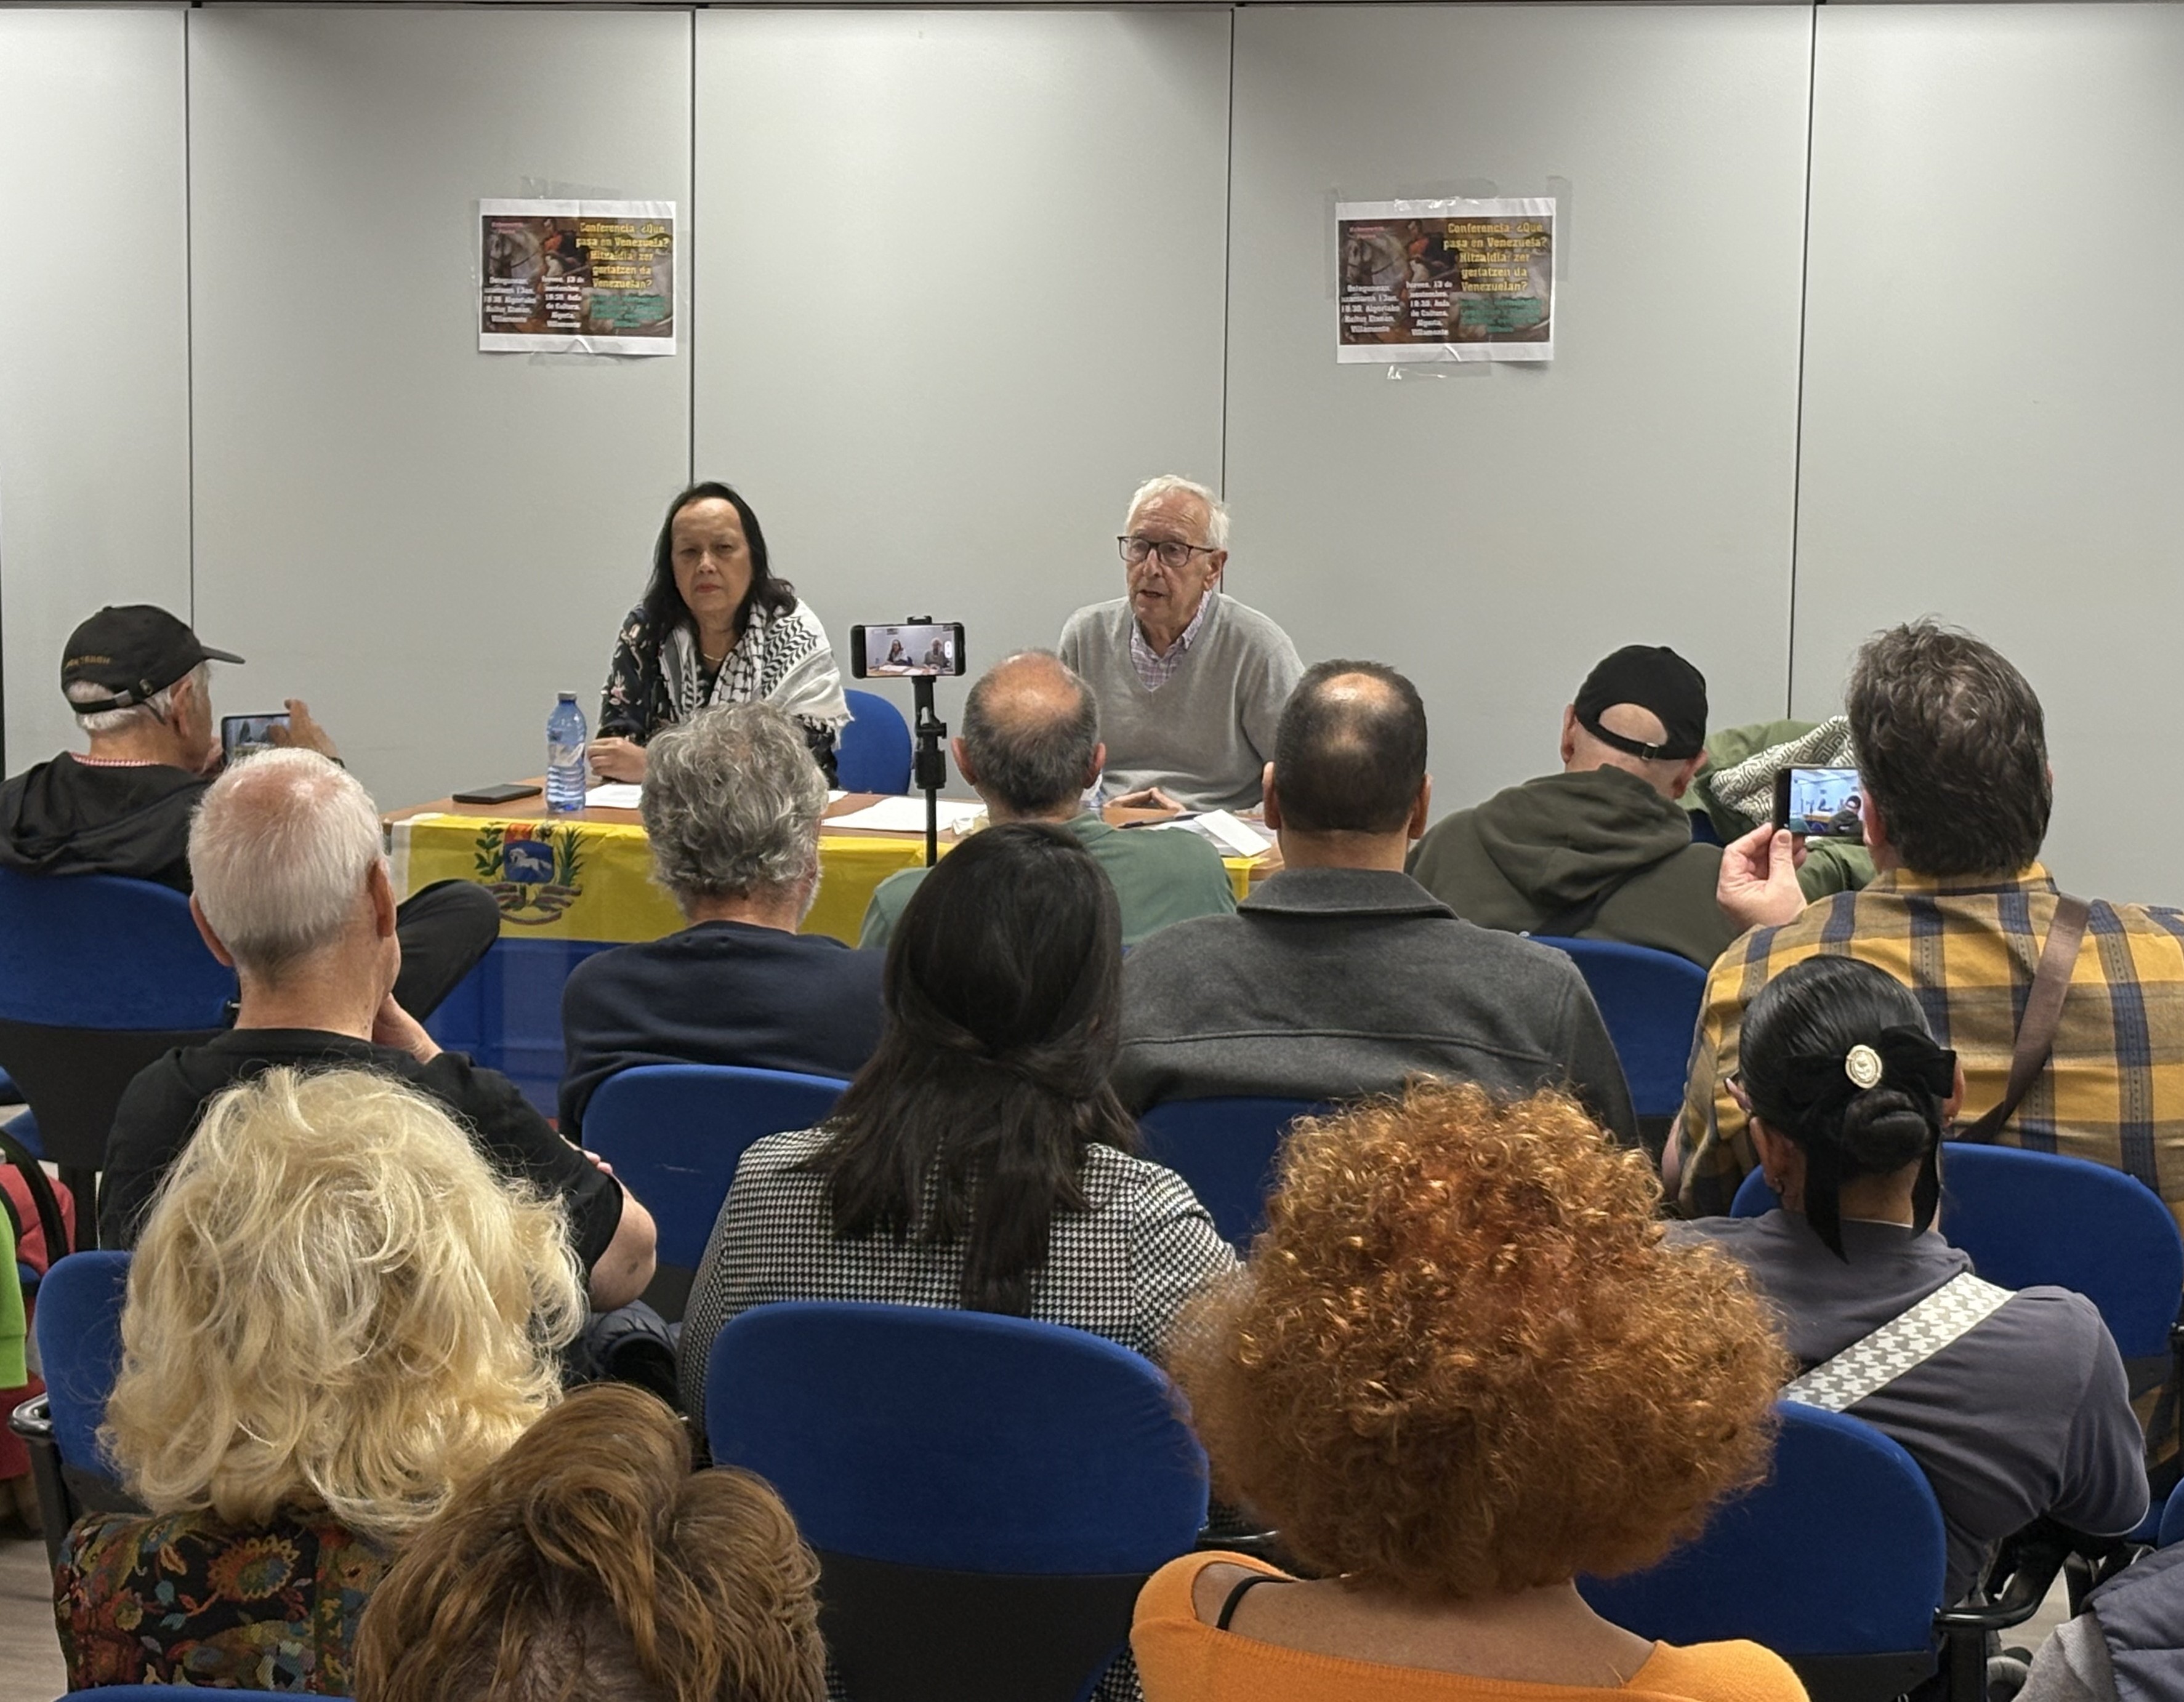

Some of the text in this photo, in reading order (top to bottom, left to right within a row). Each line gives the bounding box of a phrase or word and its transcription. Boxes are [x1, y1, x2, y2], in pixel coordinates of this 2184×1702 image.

[576, 238, 598, 248] pasa
[615, 237, 671, 247] Venezuela?
[1443, 239, 1468, 251] pasa
[1487, 237, 1547, 247] Venezuela?
[1461, 281, 1528, 292] Venezuelan?
